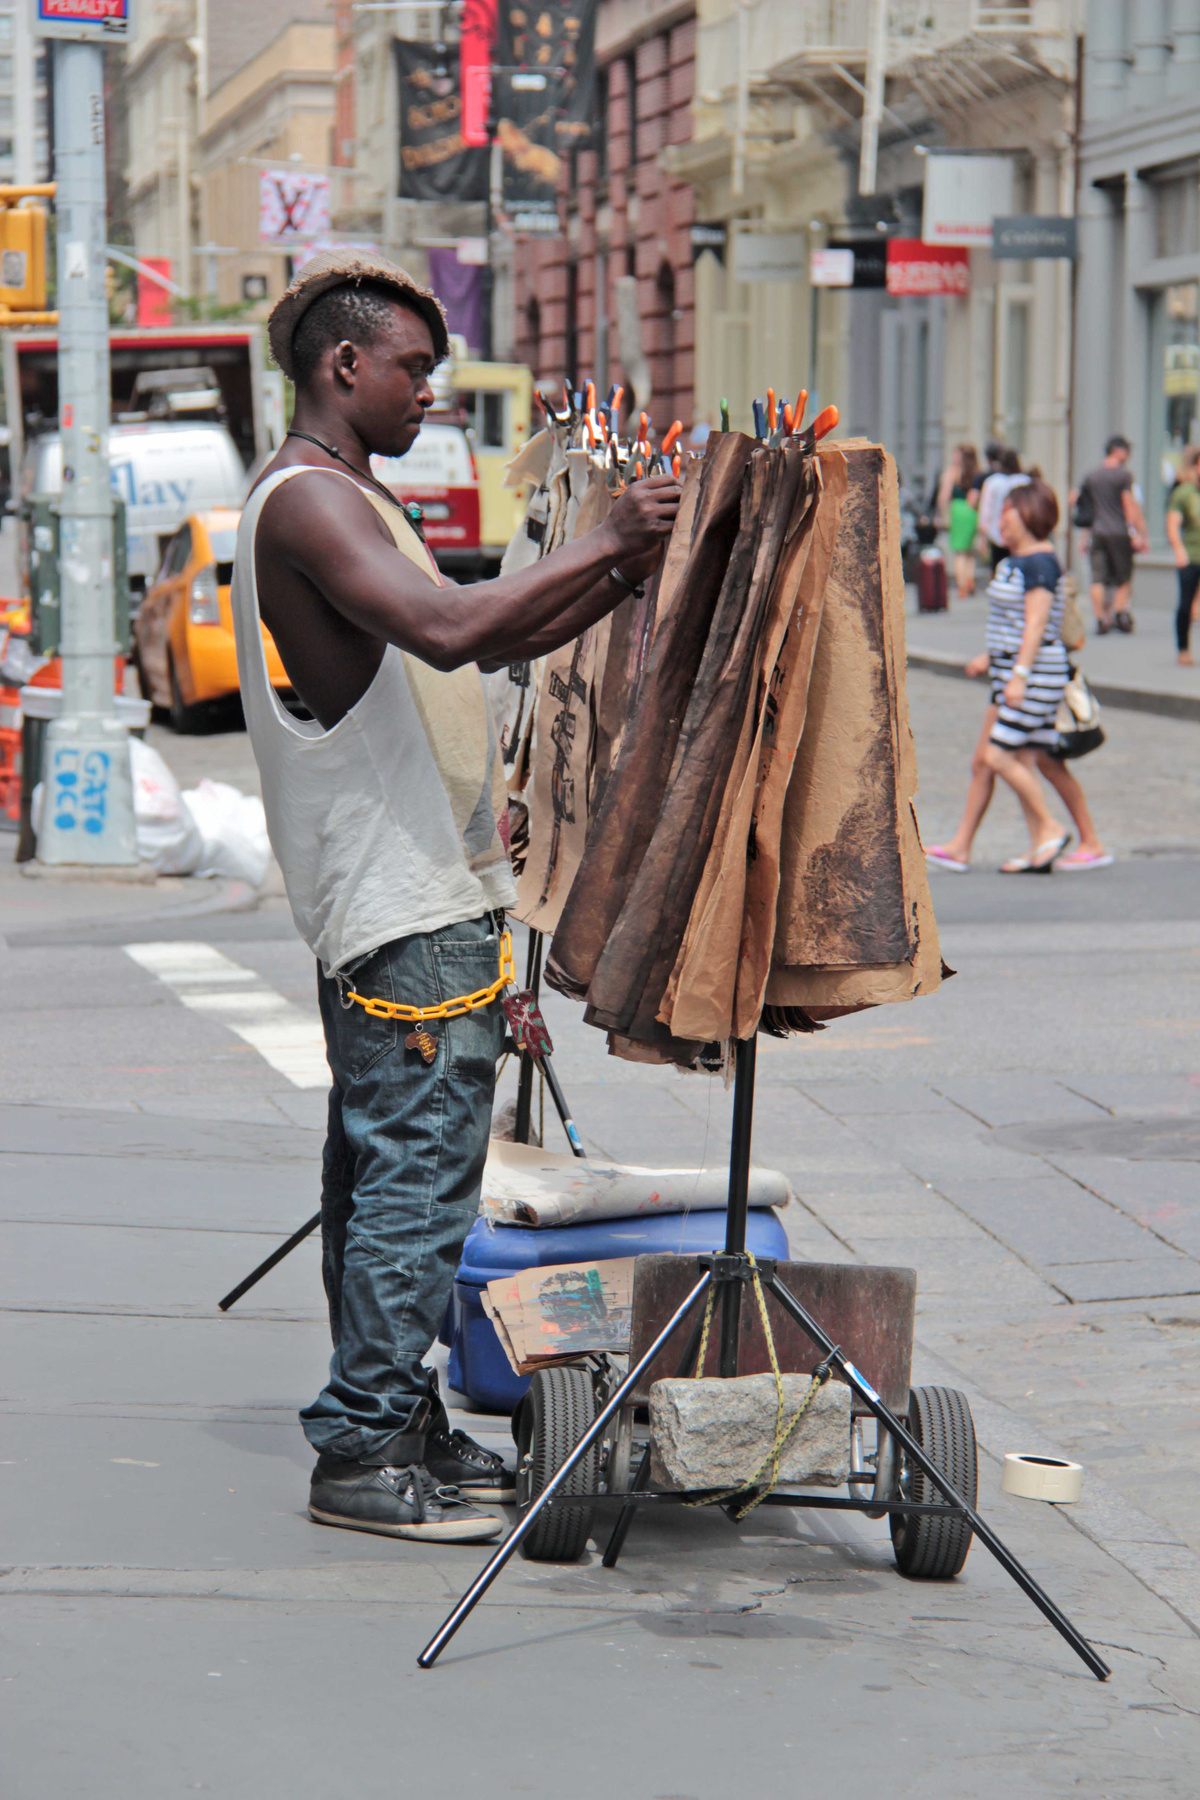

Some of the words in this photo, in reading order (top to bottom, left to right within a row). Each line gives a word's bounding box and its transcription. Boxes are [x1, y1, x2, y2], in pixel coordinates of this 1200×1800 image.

[46, 0, 120, 15] PENALTY
[54, 748, 80, 830] LOCO
[83, 750, 110, 835] GATO
